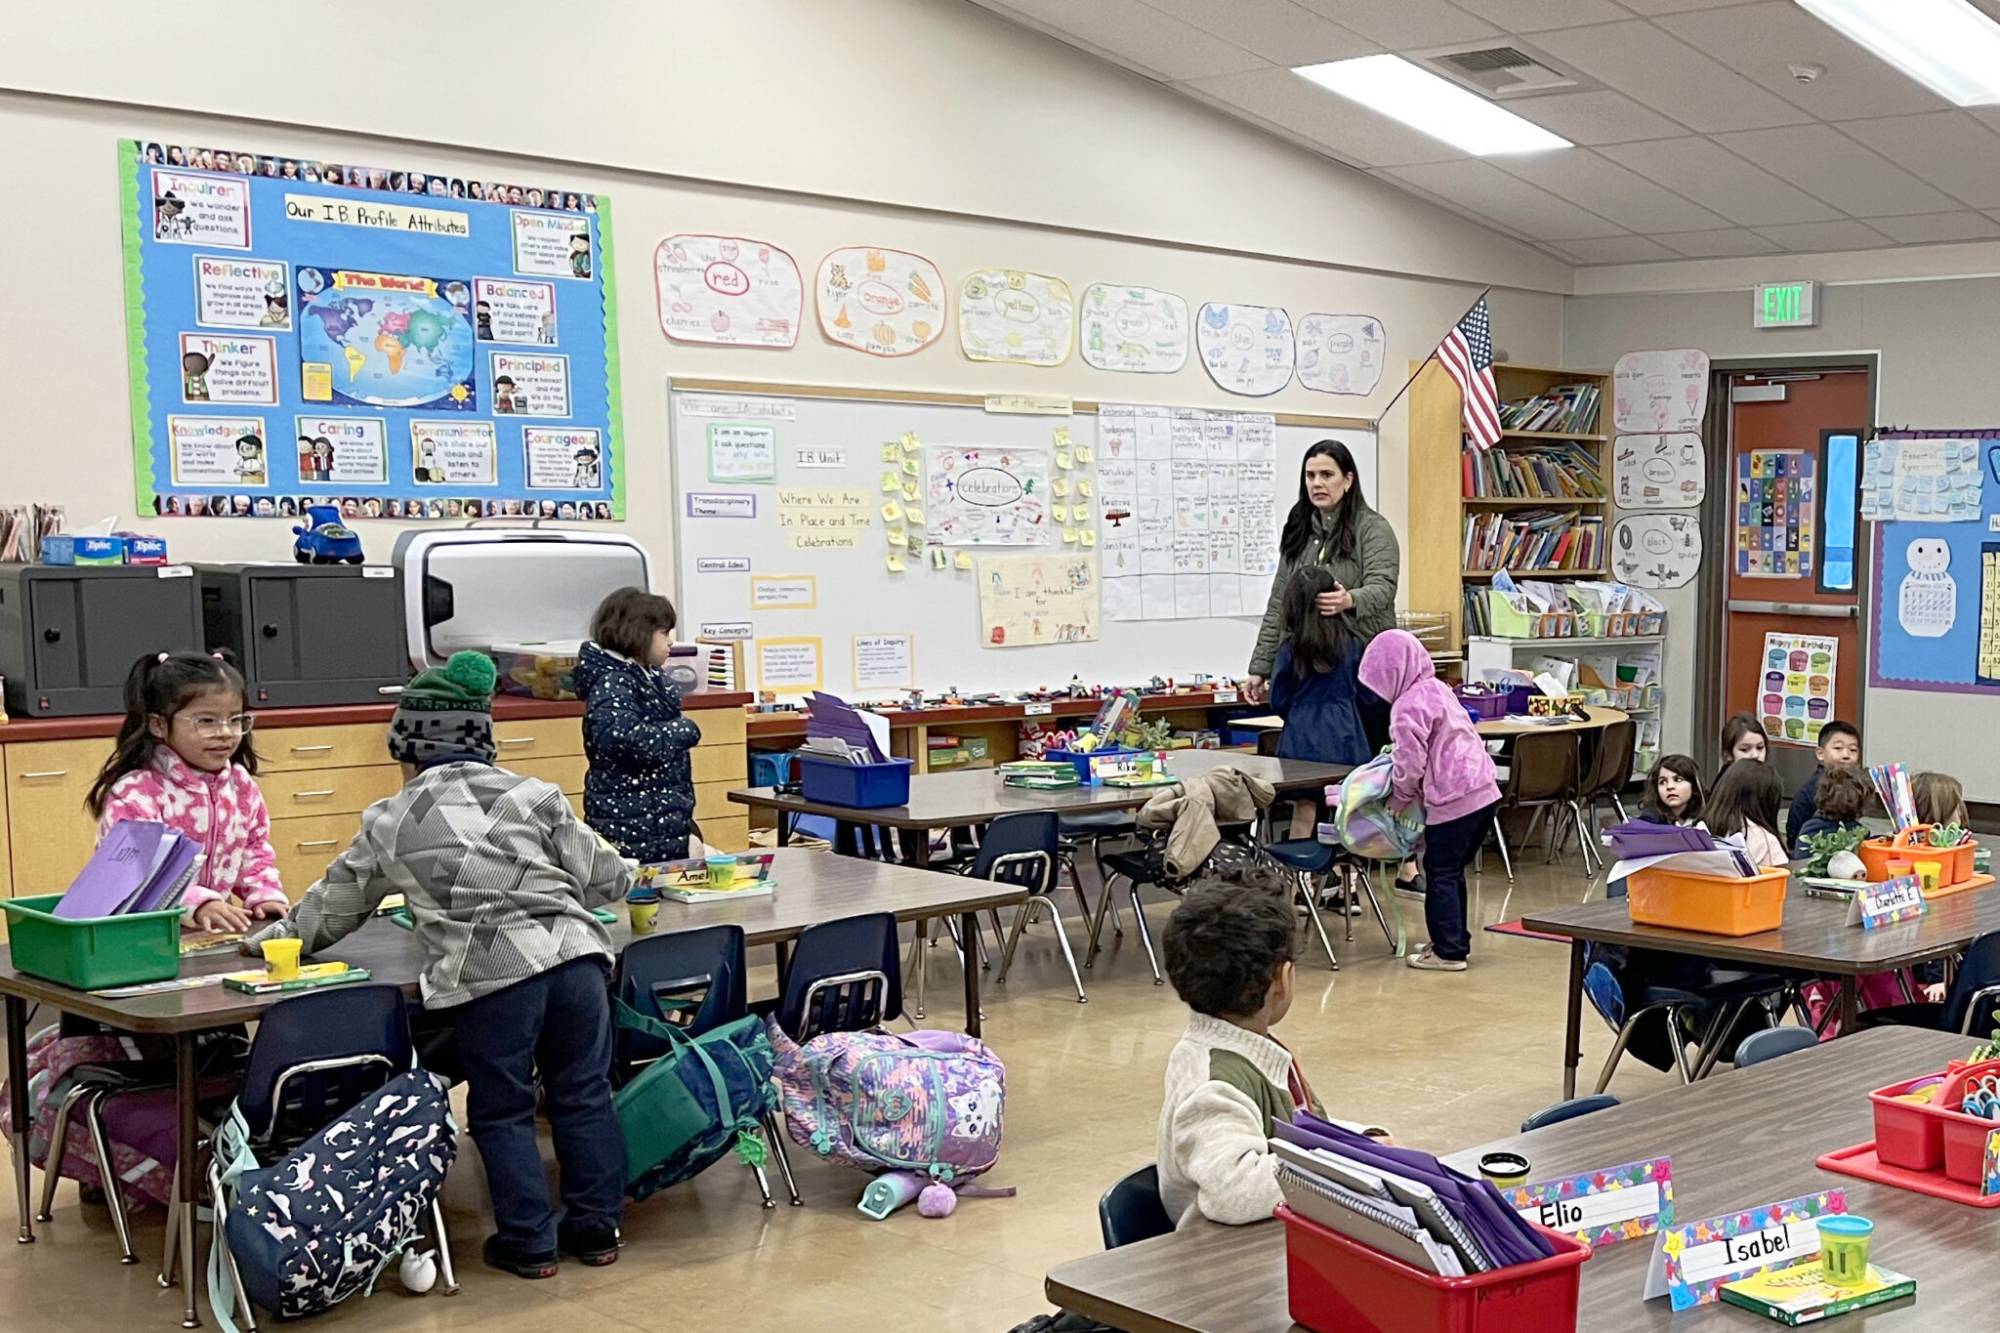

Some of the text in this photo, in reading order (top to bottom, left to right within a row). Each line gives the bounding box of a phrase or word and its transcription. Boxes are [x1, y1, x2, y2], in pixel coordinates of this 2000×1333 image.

[286, 201, 315, 219] Our
[357, 208, 398, 227] Profile
[408, 213, 467, 234] Attributes
[202, 262, 280, 280] Reflective
[712, 271, 739, 288] red
[486, 283, 545, 300] Balanced
[1764, 286, 1803, 322] EXIT
[201, 340, 257, 355] Thinker
[499, 358, 561, 373] Principled
[318, 422, 364, 438] Caring
[819, 450, 841, 464] Unit
[778, 492, 860, 505] Where We Are
[779, 514, 871, 527] In Place and Time
[87, 540, 112, 551] Ziploc
[135, 540, 163, 552] Ziploc
[796, 536, 854, 549] Celebrations
[700, 561, 726, 569] Central
[703, 627, 717, 636] Key
[1769, 638, 1832, 652] Happy Birthday
[1875, 891, 1906, 910] Charlotte
[1539, 1200, 1583, 1229] Elio
[1720, 1222, 1792, 1266] Isabel
